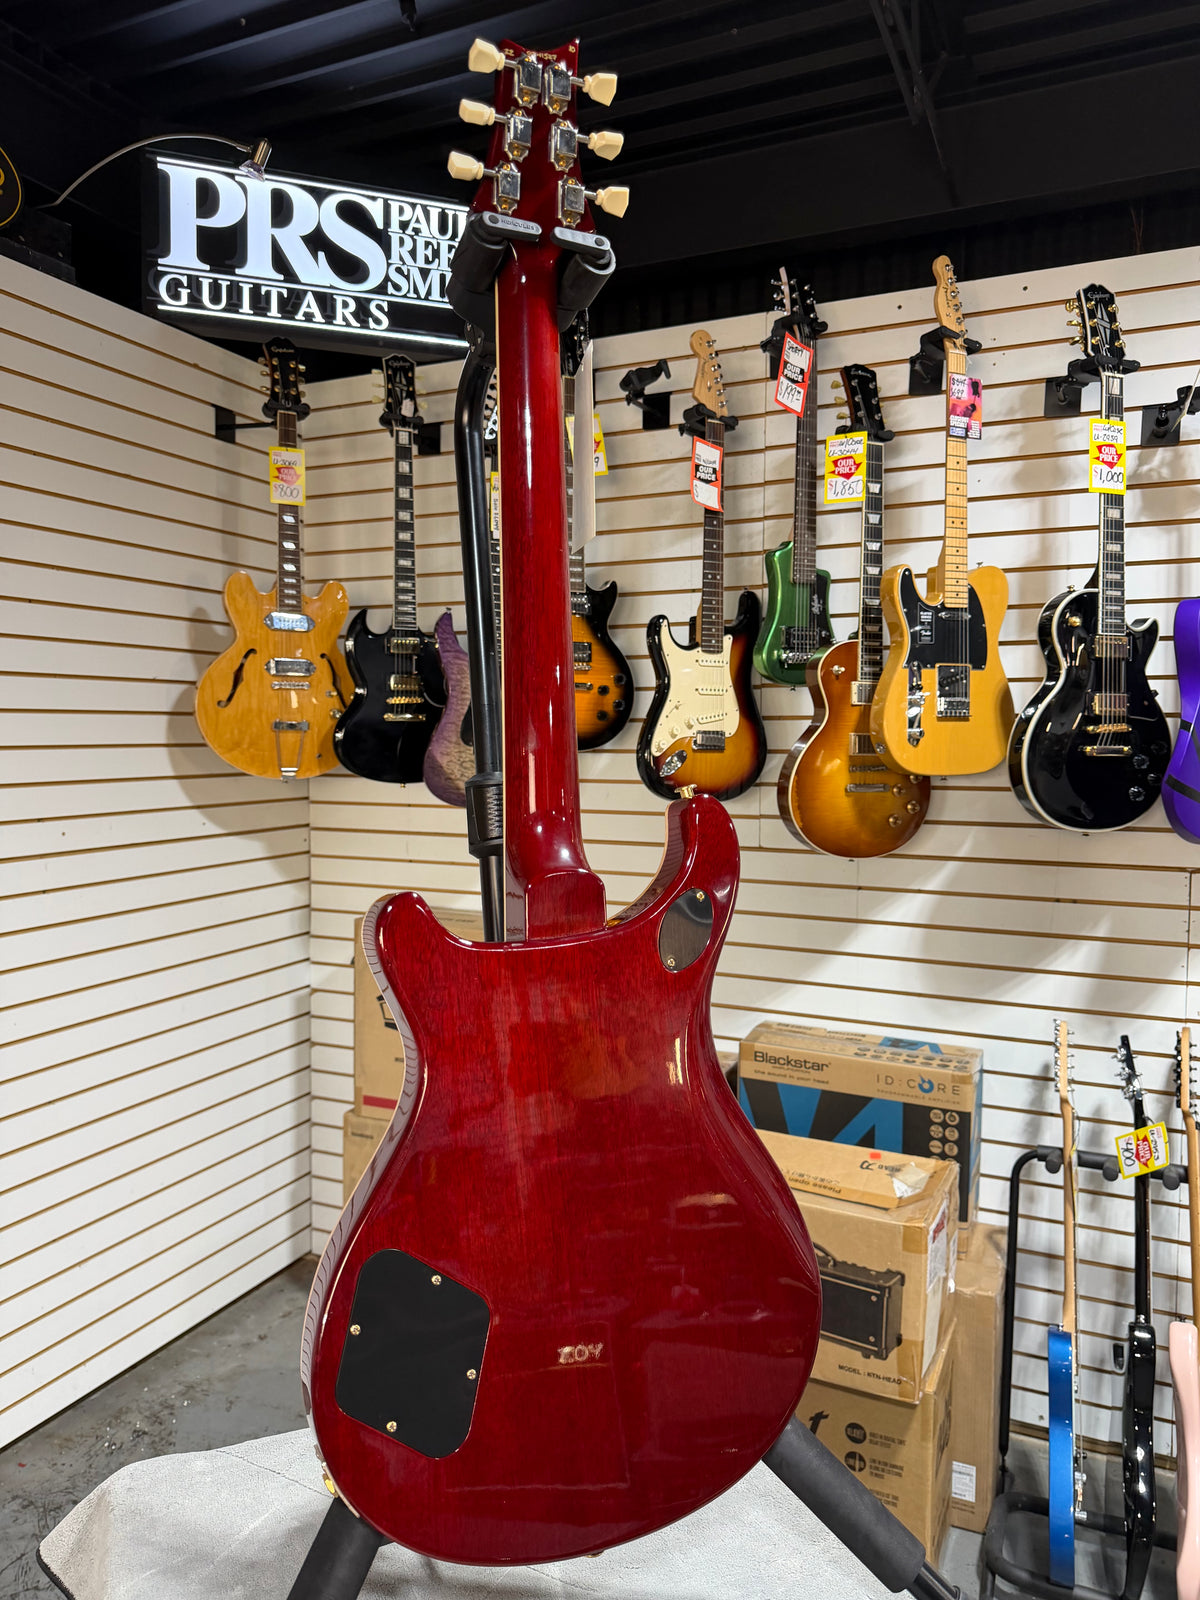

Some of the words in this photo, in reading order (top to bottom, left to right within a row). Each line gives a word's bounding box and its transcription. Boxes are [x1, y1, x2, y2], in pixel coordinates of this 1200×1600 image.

[157, 162, 388, 292] PRS
[388, 232, 459, 272] REE
[157, 273, 389, 331] GUITARS
[786, 363, 801, 373] OUR
[783, 370, 804, 382] PRICE
[1101, 446, 1117, 454] OUR
[837, 459, 855, 467] OUR
[1099, 453, 1119, 463] PRICE
[699, 465, 714, 474] OUR
[835, 465, 857, 475] PRICE
[1093, 466, 1124, 484] $1,000
[696, 471, 717, 481] PRICE
[273, 483, 300, 499] $800
[828, 479, 865, 497] $1,850
[753, 1050, 830, 1072] Blackstar
[788, 1176, 810, 1187] open
[812, 1181, 842, 1194] Please
[838, 1364, 862, 1376] MODEL
